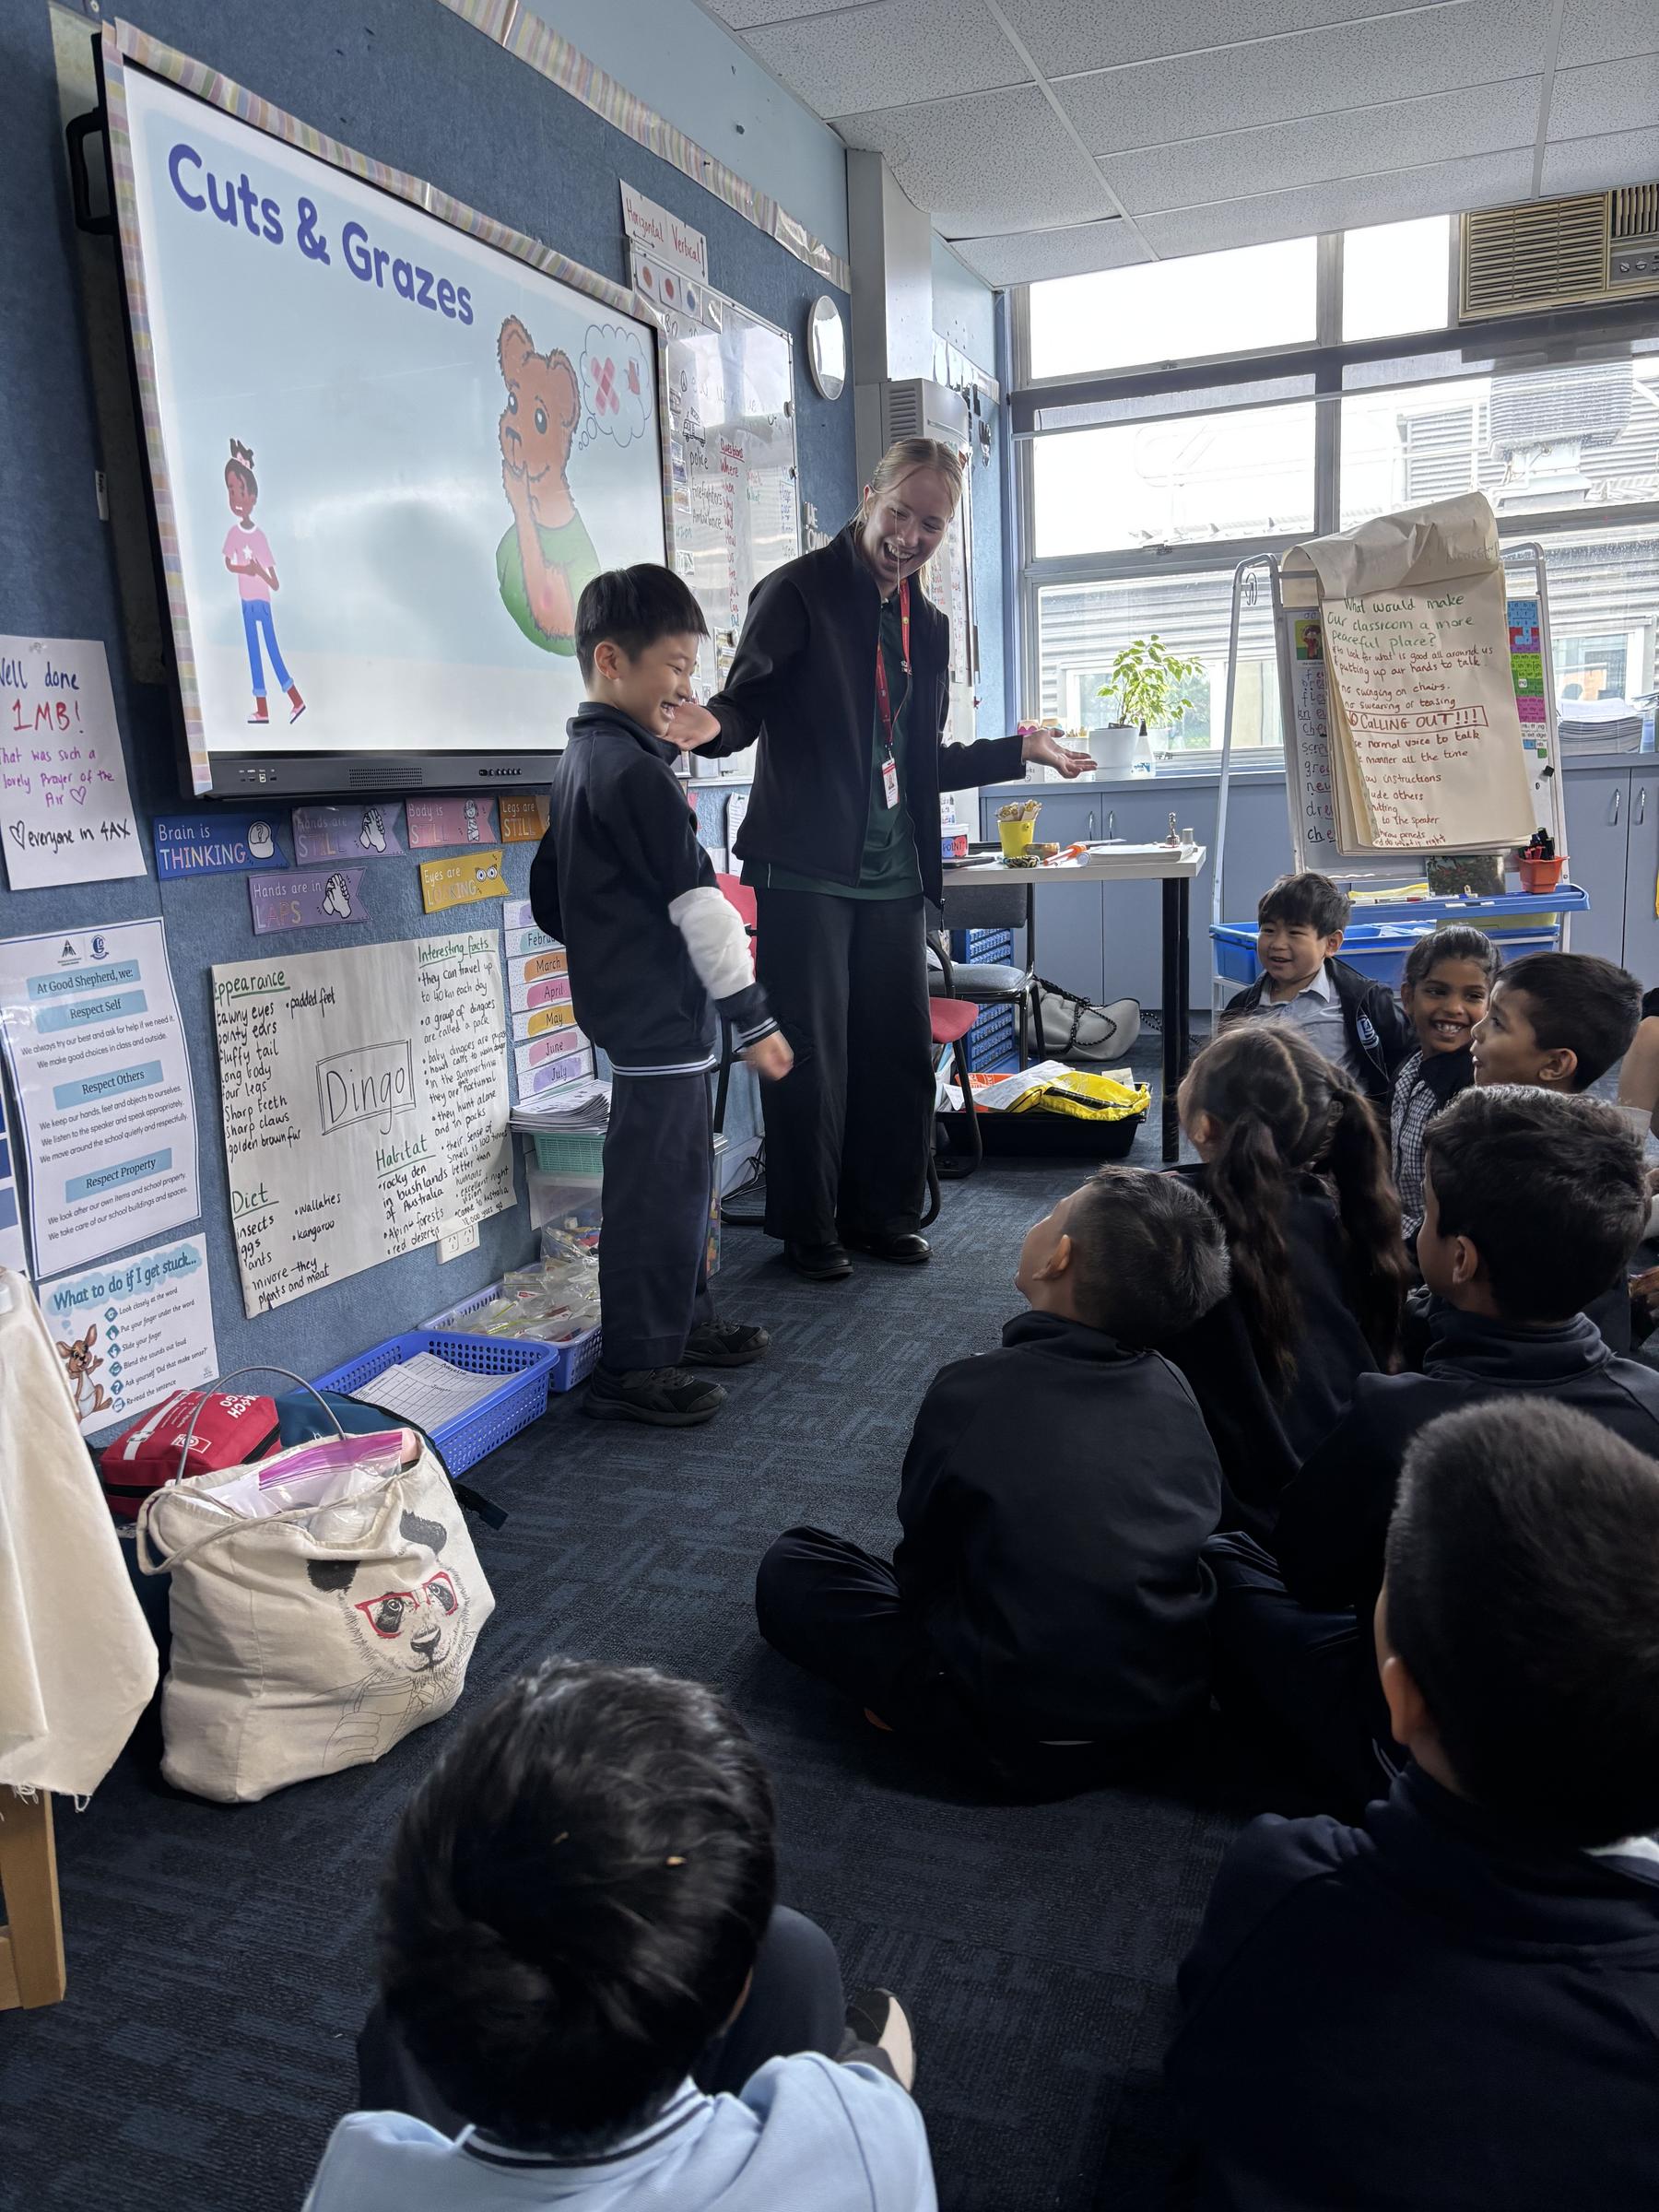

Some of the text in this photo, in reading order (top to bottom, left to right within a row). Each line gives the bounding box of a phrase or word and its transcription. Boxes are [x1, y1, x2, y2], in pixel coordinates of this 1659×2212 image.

[169, 143, 474, 325] Cuts & Grazes
[626, 197, 701, 265] Horizontal Vertical
[1345, 594, 1465, 614] What would make
[1436, 616, 1474, 629] more
[1332, 629, 1436, 655] peaceful place?
[45, 661, 80, 690] done
[1340, 664, 1370, 683] putting
[1373, 668, 1386, 682] up
[1410, 662, 1438, 673] hands
[1441, 660, 1453, 668] to
[1457, 656, 1480, 667] talk
[1419, 698, 1456, 710] teasing
[1368, 739, 1400, 749] normal
[1437, 734, 1449, 745] to
[1455, 730, 1480, 741] talk
[31, 749, 52, 763] was
[58, 747, 80, 761] such
[88, 748, 96, 760] a
[1402, 755, 1416, 763] all
[1421, 753, 1439, 761] the
[3, 769, 115, 794] lovely Prayer of the
[1383, 774, 1441, 783] instructions
[1394, 790, 1423, 801] others
[408, 804, 443, 821] Body is
[502, 802, 536, 816] Legs are
[159, 823, 210, 841] Brain is
[332, 818, 347, 827] are
[504, 818, 536, 838] STILL
[1412, 817, 1440, 828] speaker
[29, 827, 75, 853] everyone
[79, 829, 94, 842] in
[411, 825, 449, 844] STILL
[159, 842, 247, 871] THINKING
[299, 835, 347, 858] STILL
[424, 867, 461, 887] Eyes are
[253, 880, 323, 899] Hands are in
[427, 880, 477, 907] LOOKING
[254, 900, 301, 929] LAPS
[418, 935, 489, 964] Interesting facts
[536, 959, 561, 972] March
[37, 982, 48, 994] At
[49, 978, 74, 992] Good
[75, 970, 119, 989] Shepherd,
[290, 985, 335, 1019] padded feet
[545, 983, 563, 1003] April
[70, 998, 123, 1019] Respect Self
[217, 1001, 274, 1027] tawny eyes
[253, 1022, 277, 1038] ears
[546, 1012, 563, 1028] May
[256, 1039, 278, 1061] tail
[546, 1041, 564, 1057] June
[247, 1062, 271, 1080] body
[551, 1065, 568, 1082] July
[82, 1070, 145, 1096] Respect Others
[245, 1081, 266, 1099] legs
[258, 1095, 288, 1112] teeth
[326, 1066, 406, 1135] Dingo
[259, 1112, 289, 1129] claws
[229, 1126, 301, 1164] golden brown fur
[375, 1135, 428, 1171] Habitat
[86, 1159, 157, 1189] Respect Property
[299, 1193, 342, 1216] wallabies
[297, 1219, 335, 1242] kangaroo
[54, 1252, 197, 1311] What to do if I get stuck...
[119, 1287, 178, 1315] Look closely at the word
[120, 1300, 195, 1334] Put your finger under the word
[122, 1331, 162, 1352] Slide your finger
[124, 1338, 187, 1369] Blend the sounds out loud
[126, 1379, 176, 1406] Re-read the sentence
